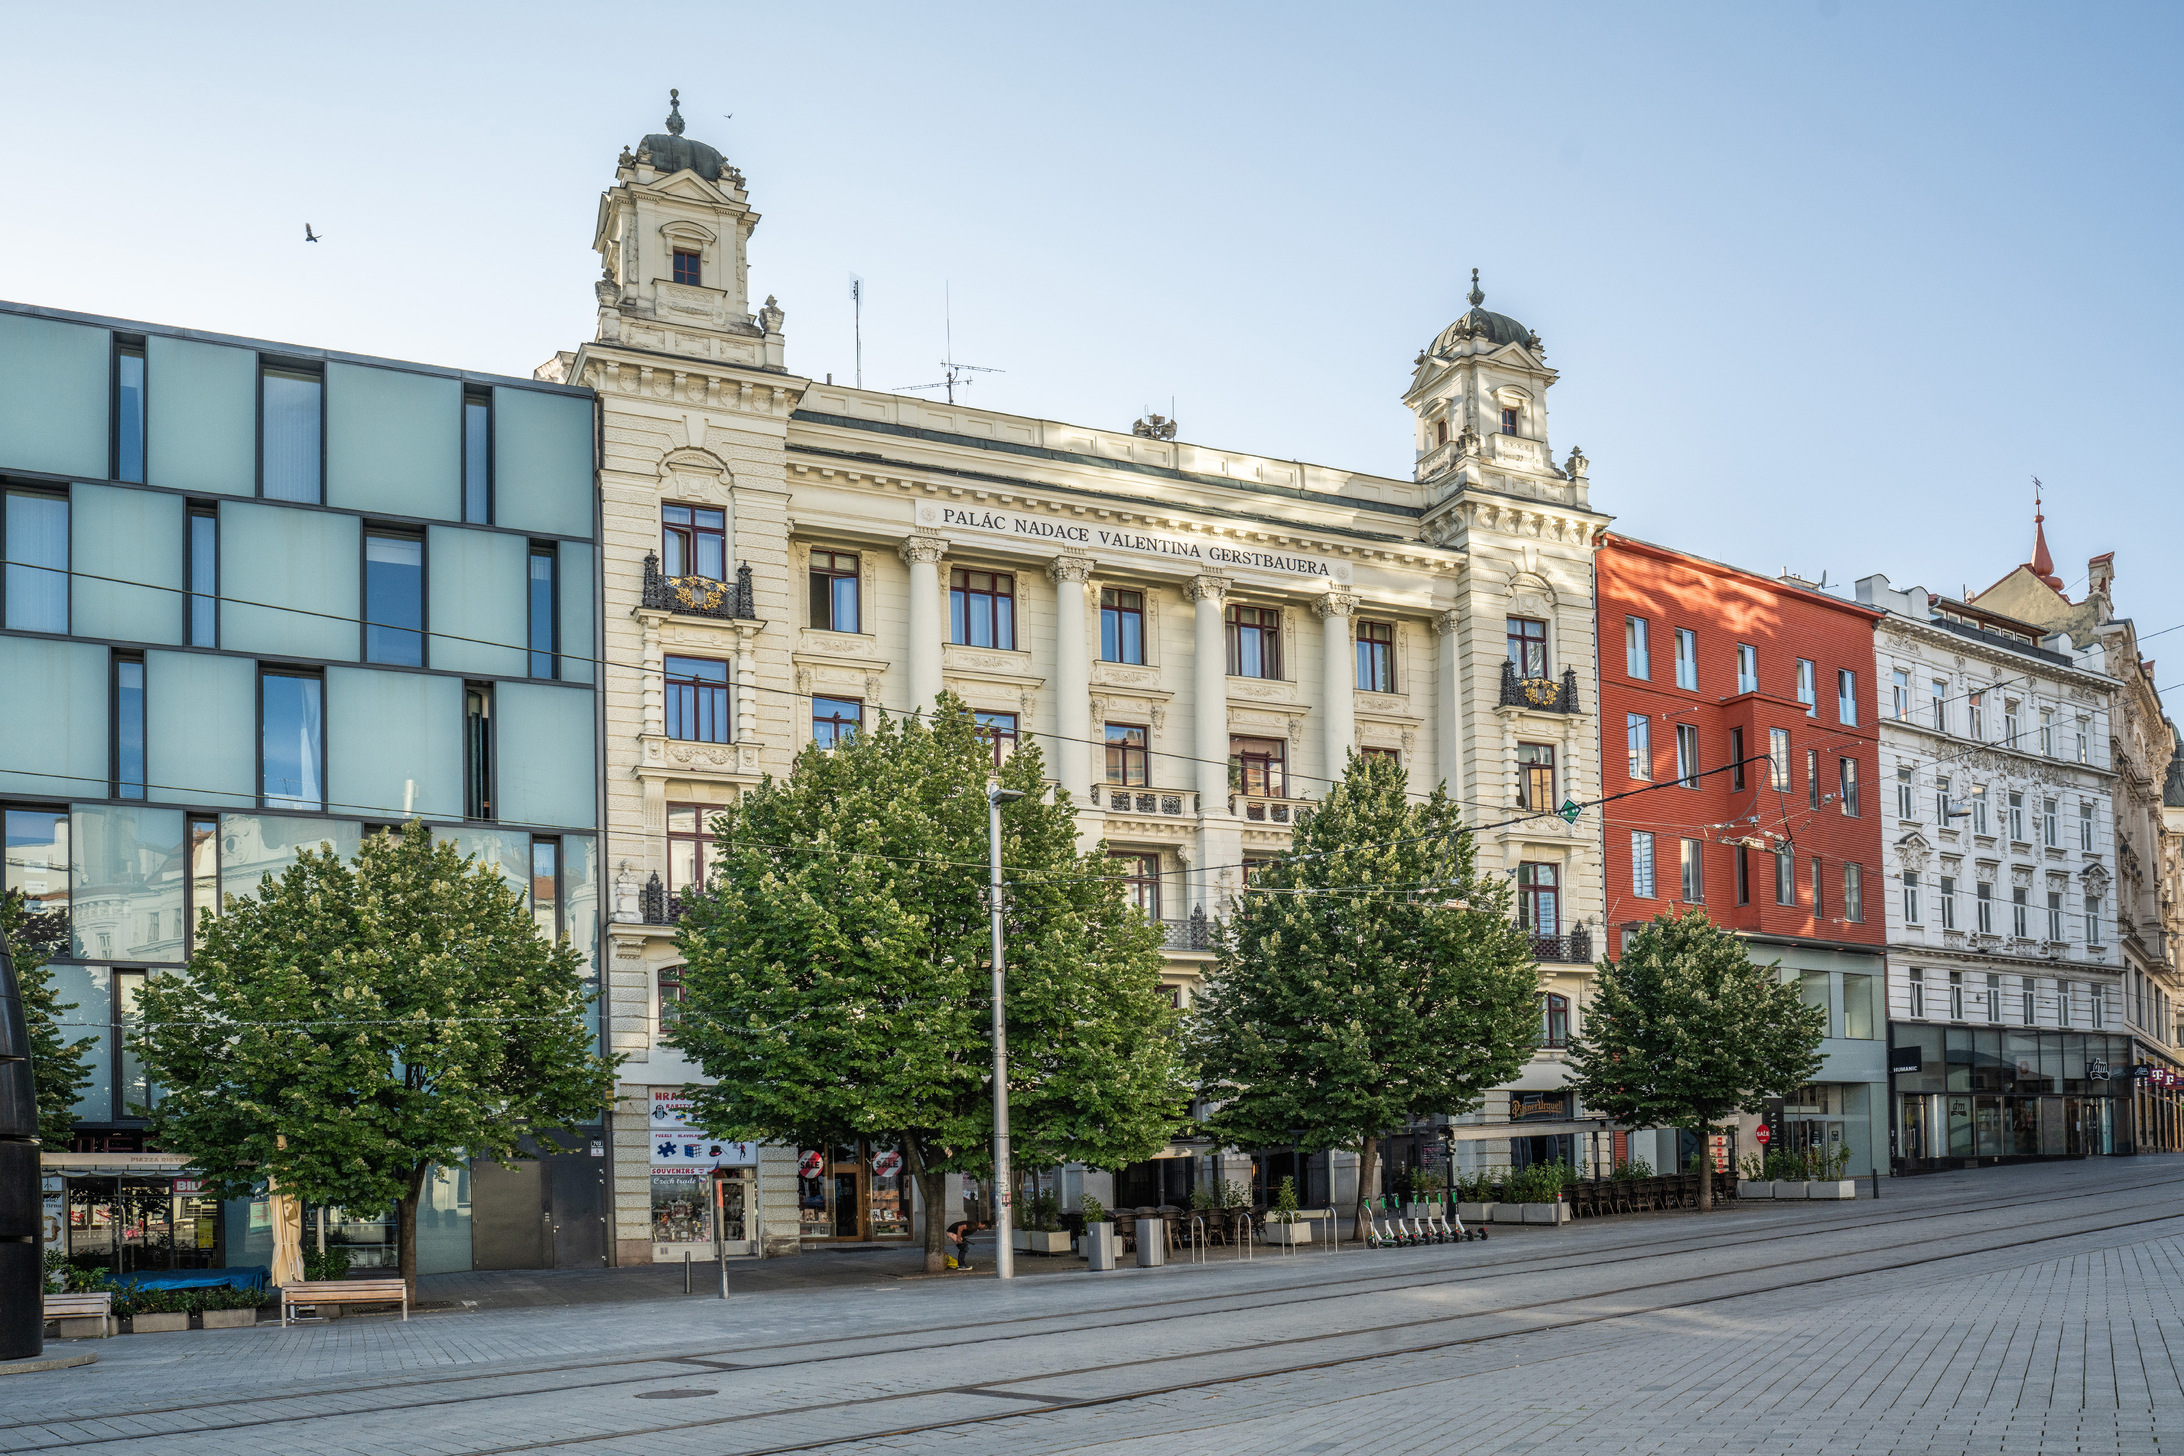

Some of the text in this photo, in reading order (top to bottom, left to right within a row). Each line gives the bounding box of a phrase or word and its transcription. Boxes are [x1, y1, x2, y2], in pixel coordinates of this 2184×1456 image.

[943, 508, 1330, 576] PALÁC NADACE VALENTINA GERSTBAUERA
[1893, 1065, 1918, 1073] HUMANIC
[2152, 1069, 2164, 1081] T
[655, 1092, 690, 1101] HRA
[1512, 1099, 1562, 1118] Pilsner Urquell
[1952, 1099, 1965, 1111] dm
[800, 1161, 820, 1169] SALE
[876, 1160, 899, 1168] SALE
[176, 1181, 205, 1191] BIL
